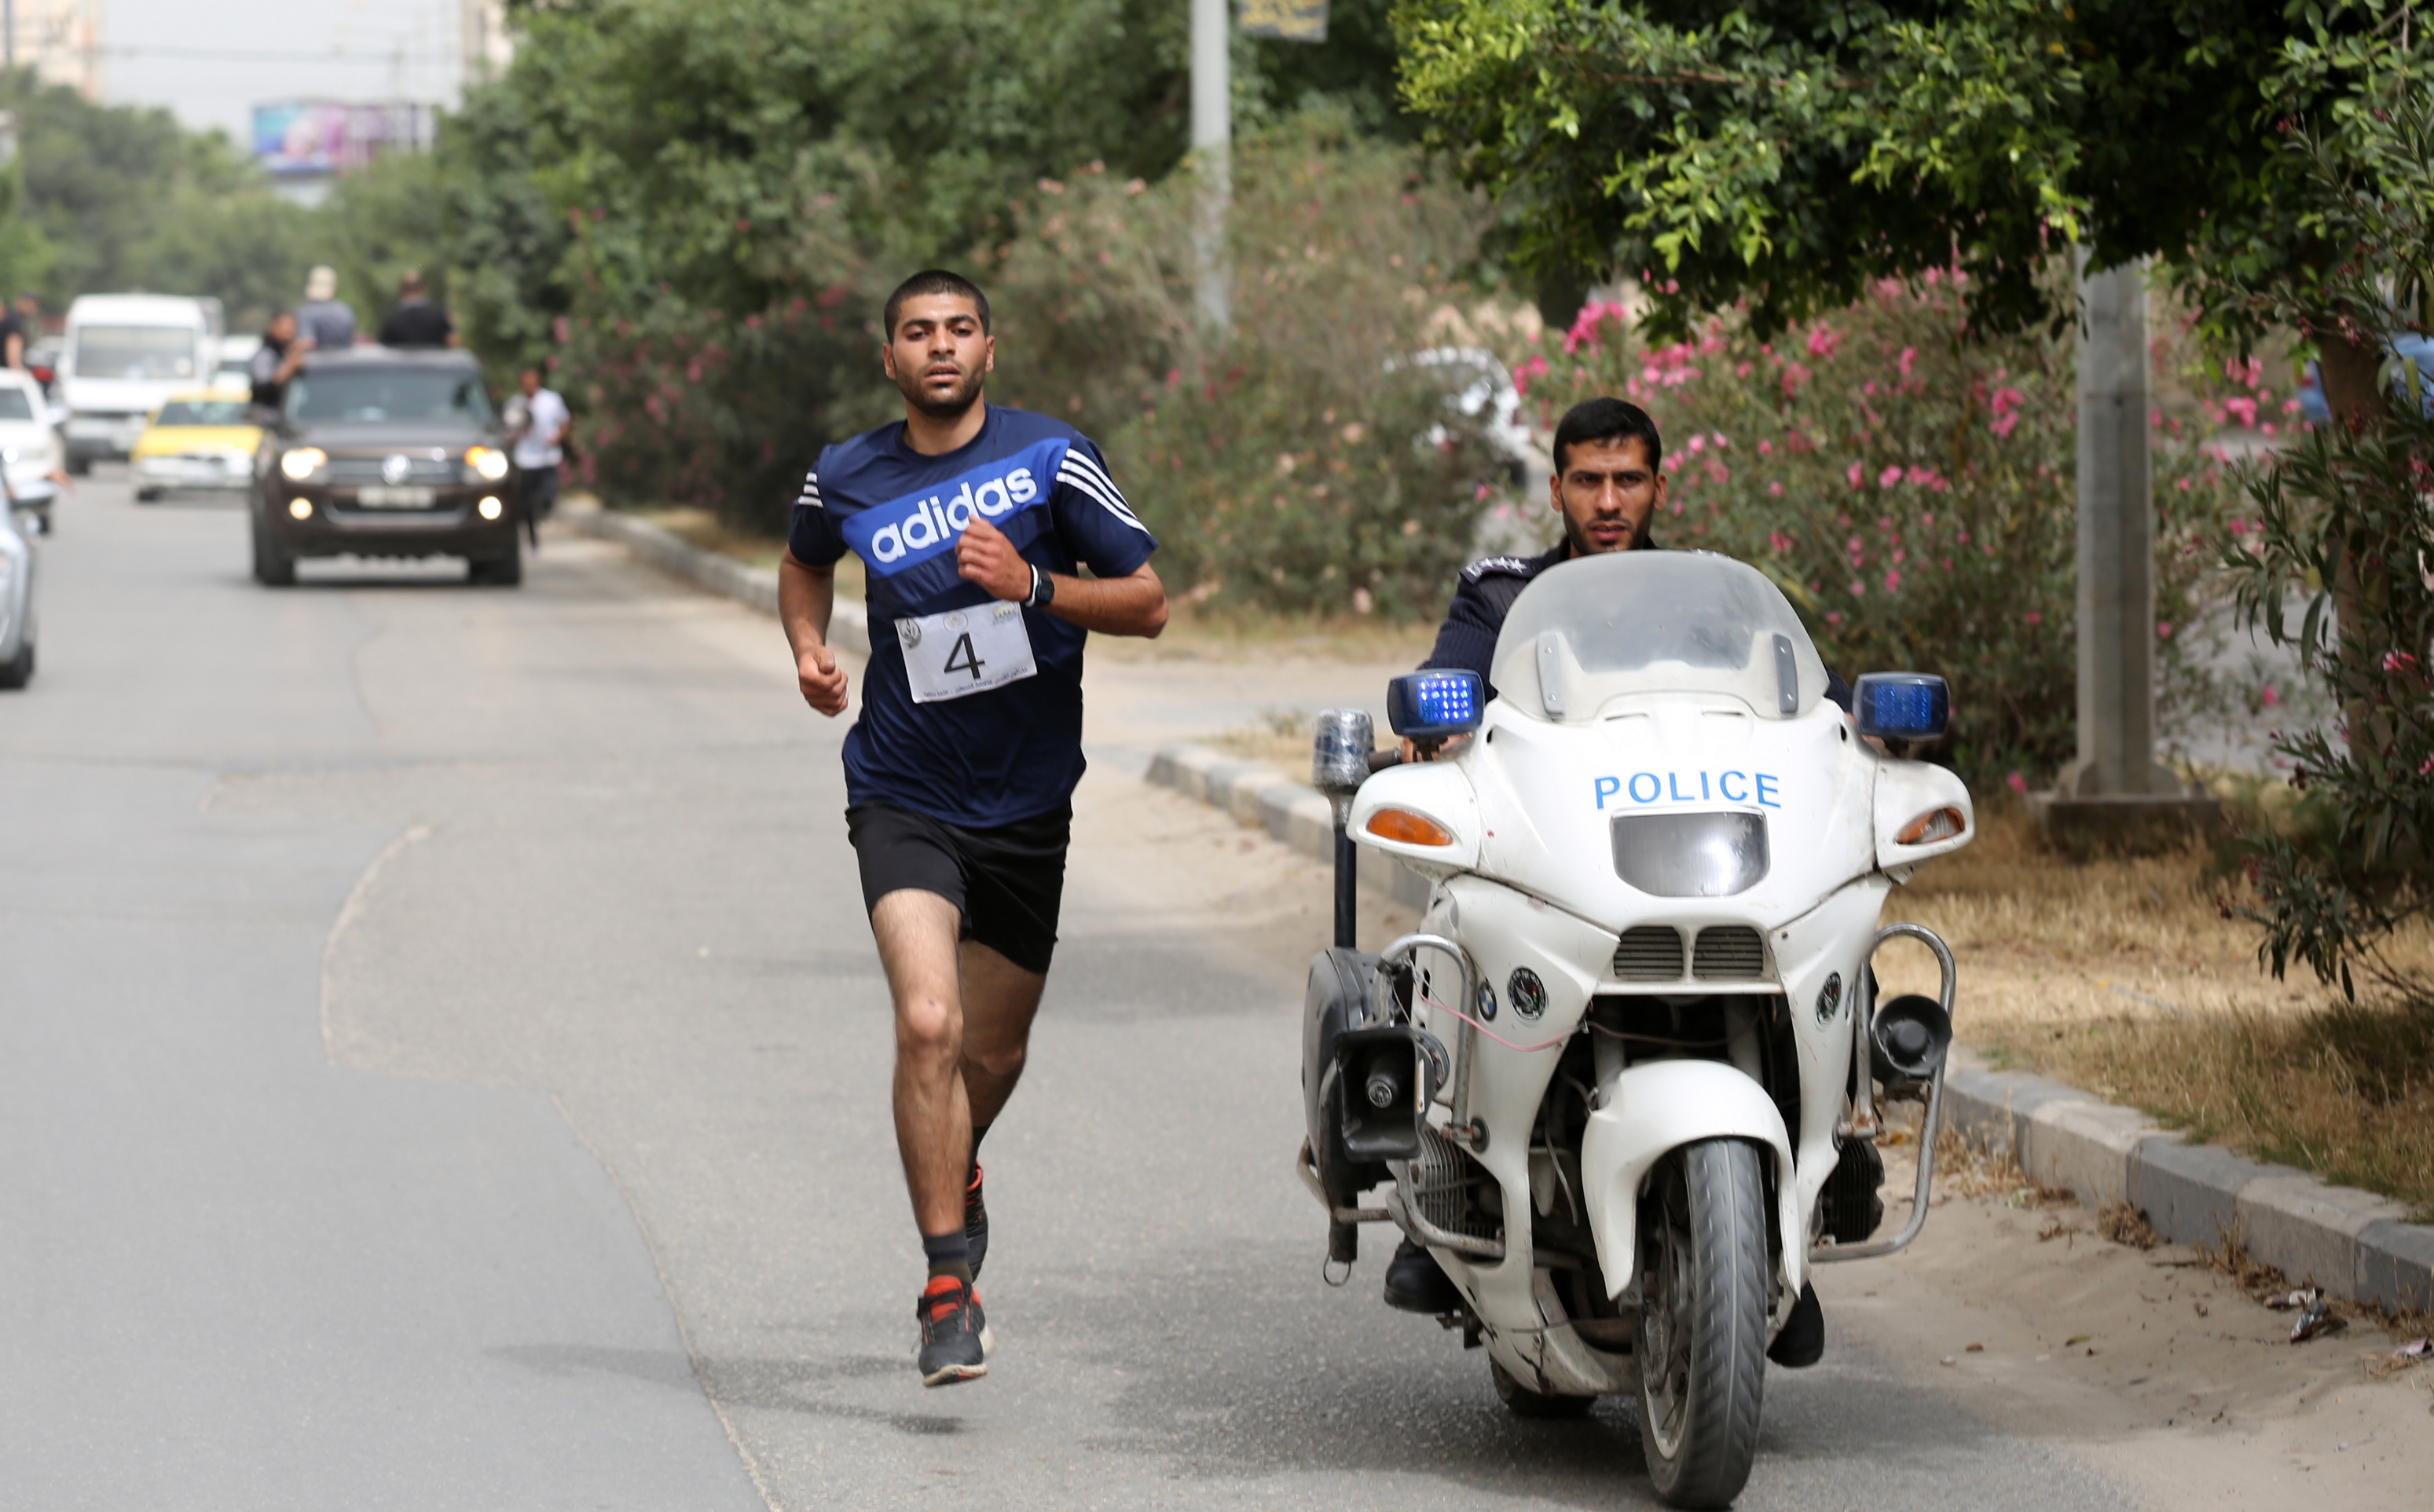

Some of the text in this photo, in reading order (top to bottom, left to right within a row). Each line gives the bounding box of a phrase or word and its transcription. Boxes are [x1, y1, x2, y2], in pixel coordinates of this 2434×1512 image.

[871, 467, 1038, 563] adidas
[944, 632, 985, 679] 4
[1594, 770, 1781, 810] POLICE
